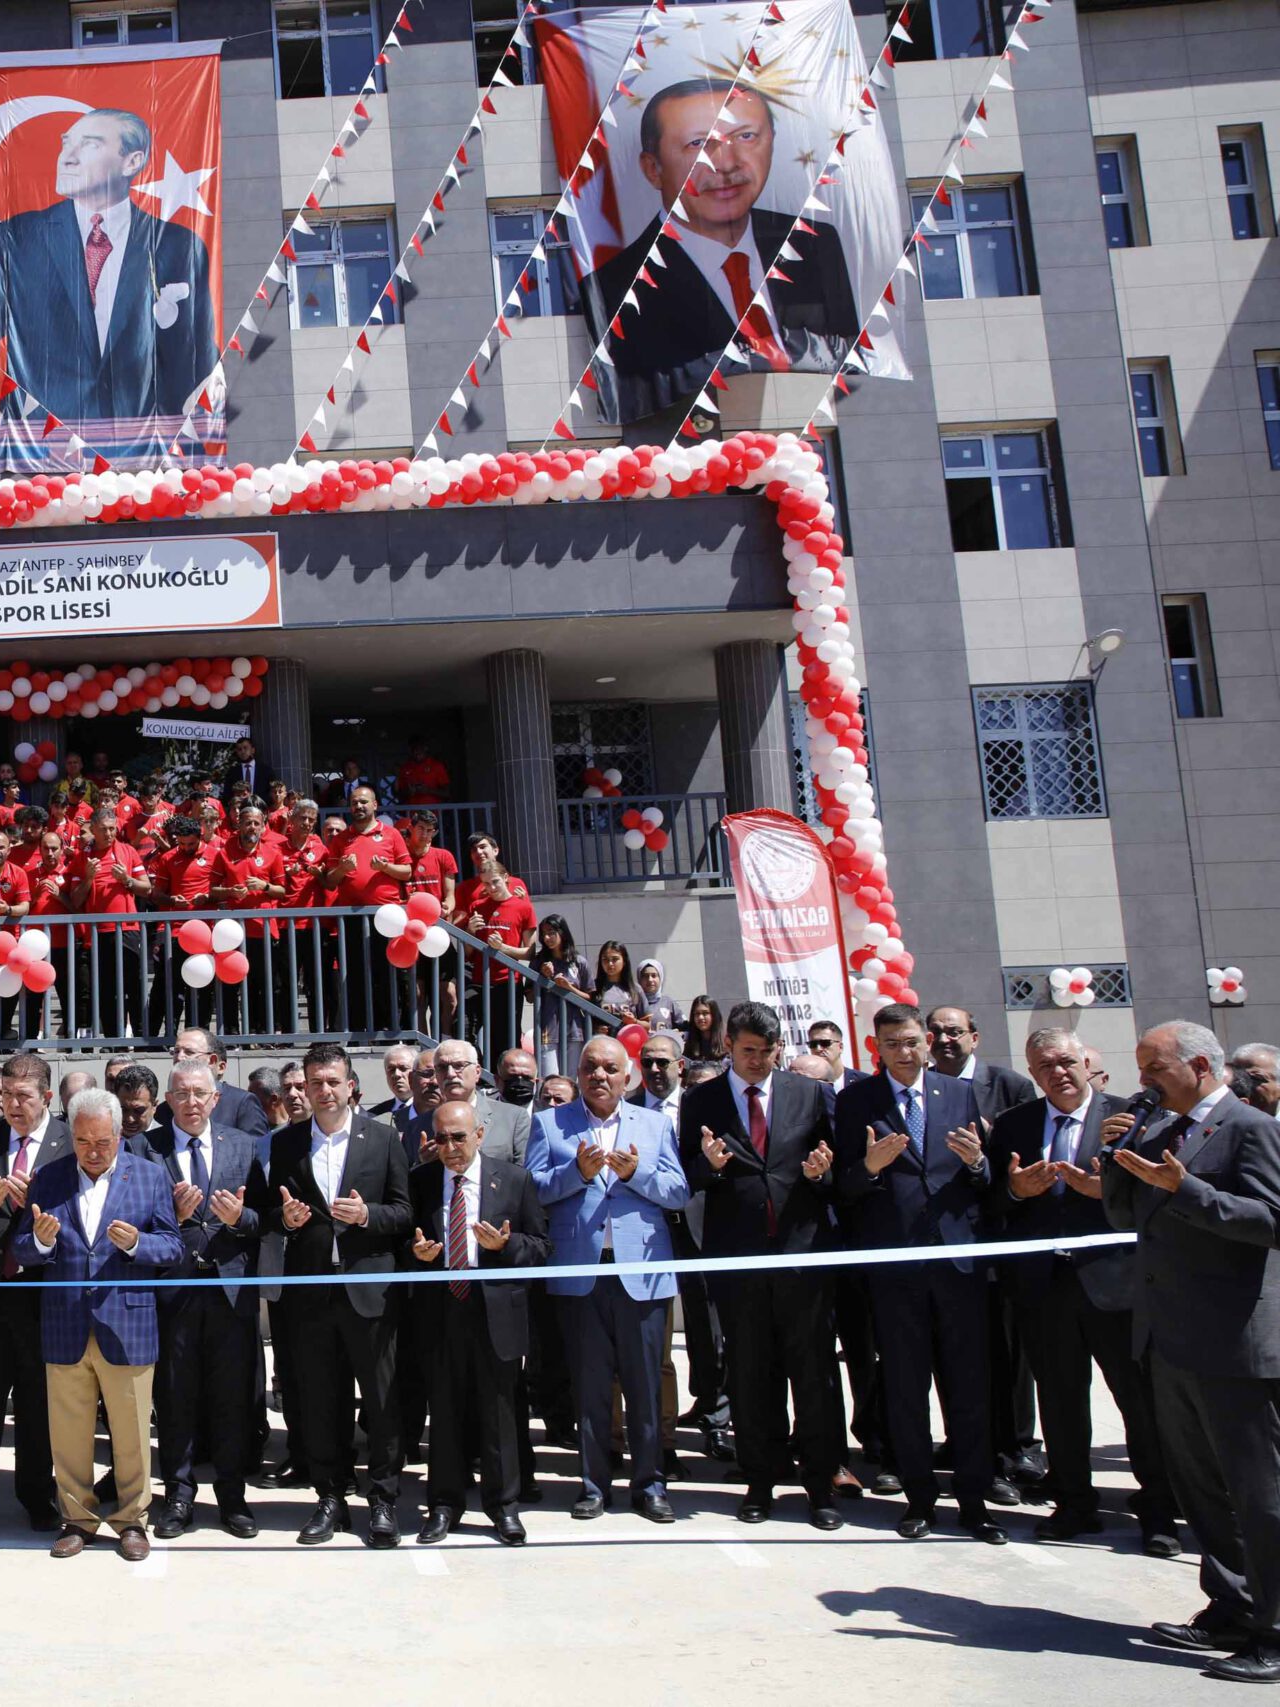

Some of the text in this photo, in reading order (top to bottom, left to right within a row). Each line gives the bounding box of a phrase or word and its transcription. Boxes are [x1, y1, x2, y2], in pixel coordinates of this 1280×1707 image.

[77, 554, 144, 572] ŞAHİNBEY
[43, 572, 91, 593] SANİ
[97, 567, 229, 591] KONUKOĞLU
[51, 598, 111, 620] LİSESİ
[145, 723, 215, 738] KONUKOĞLU
